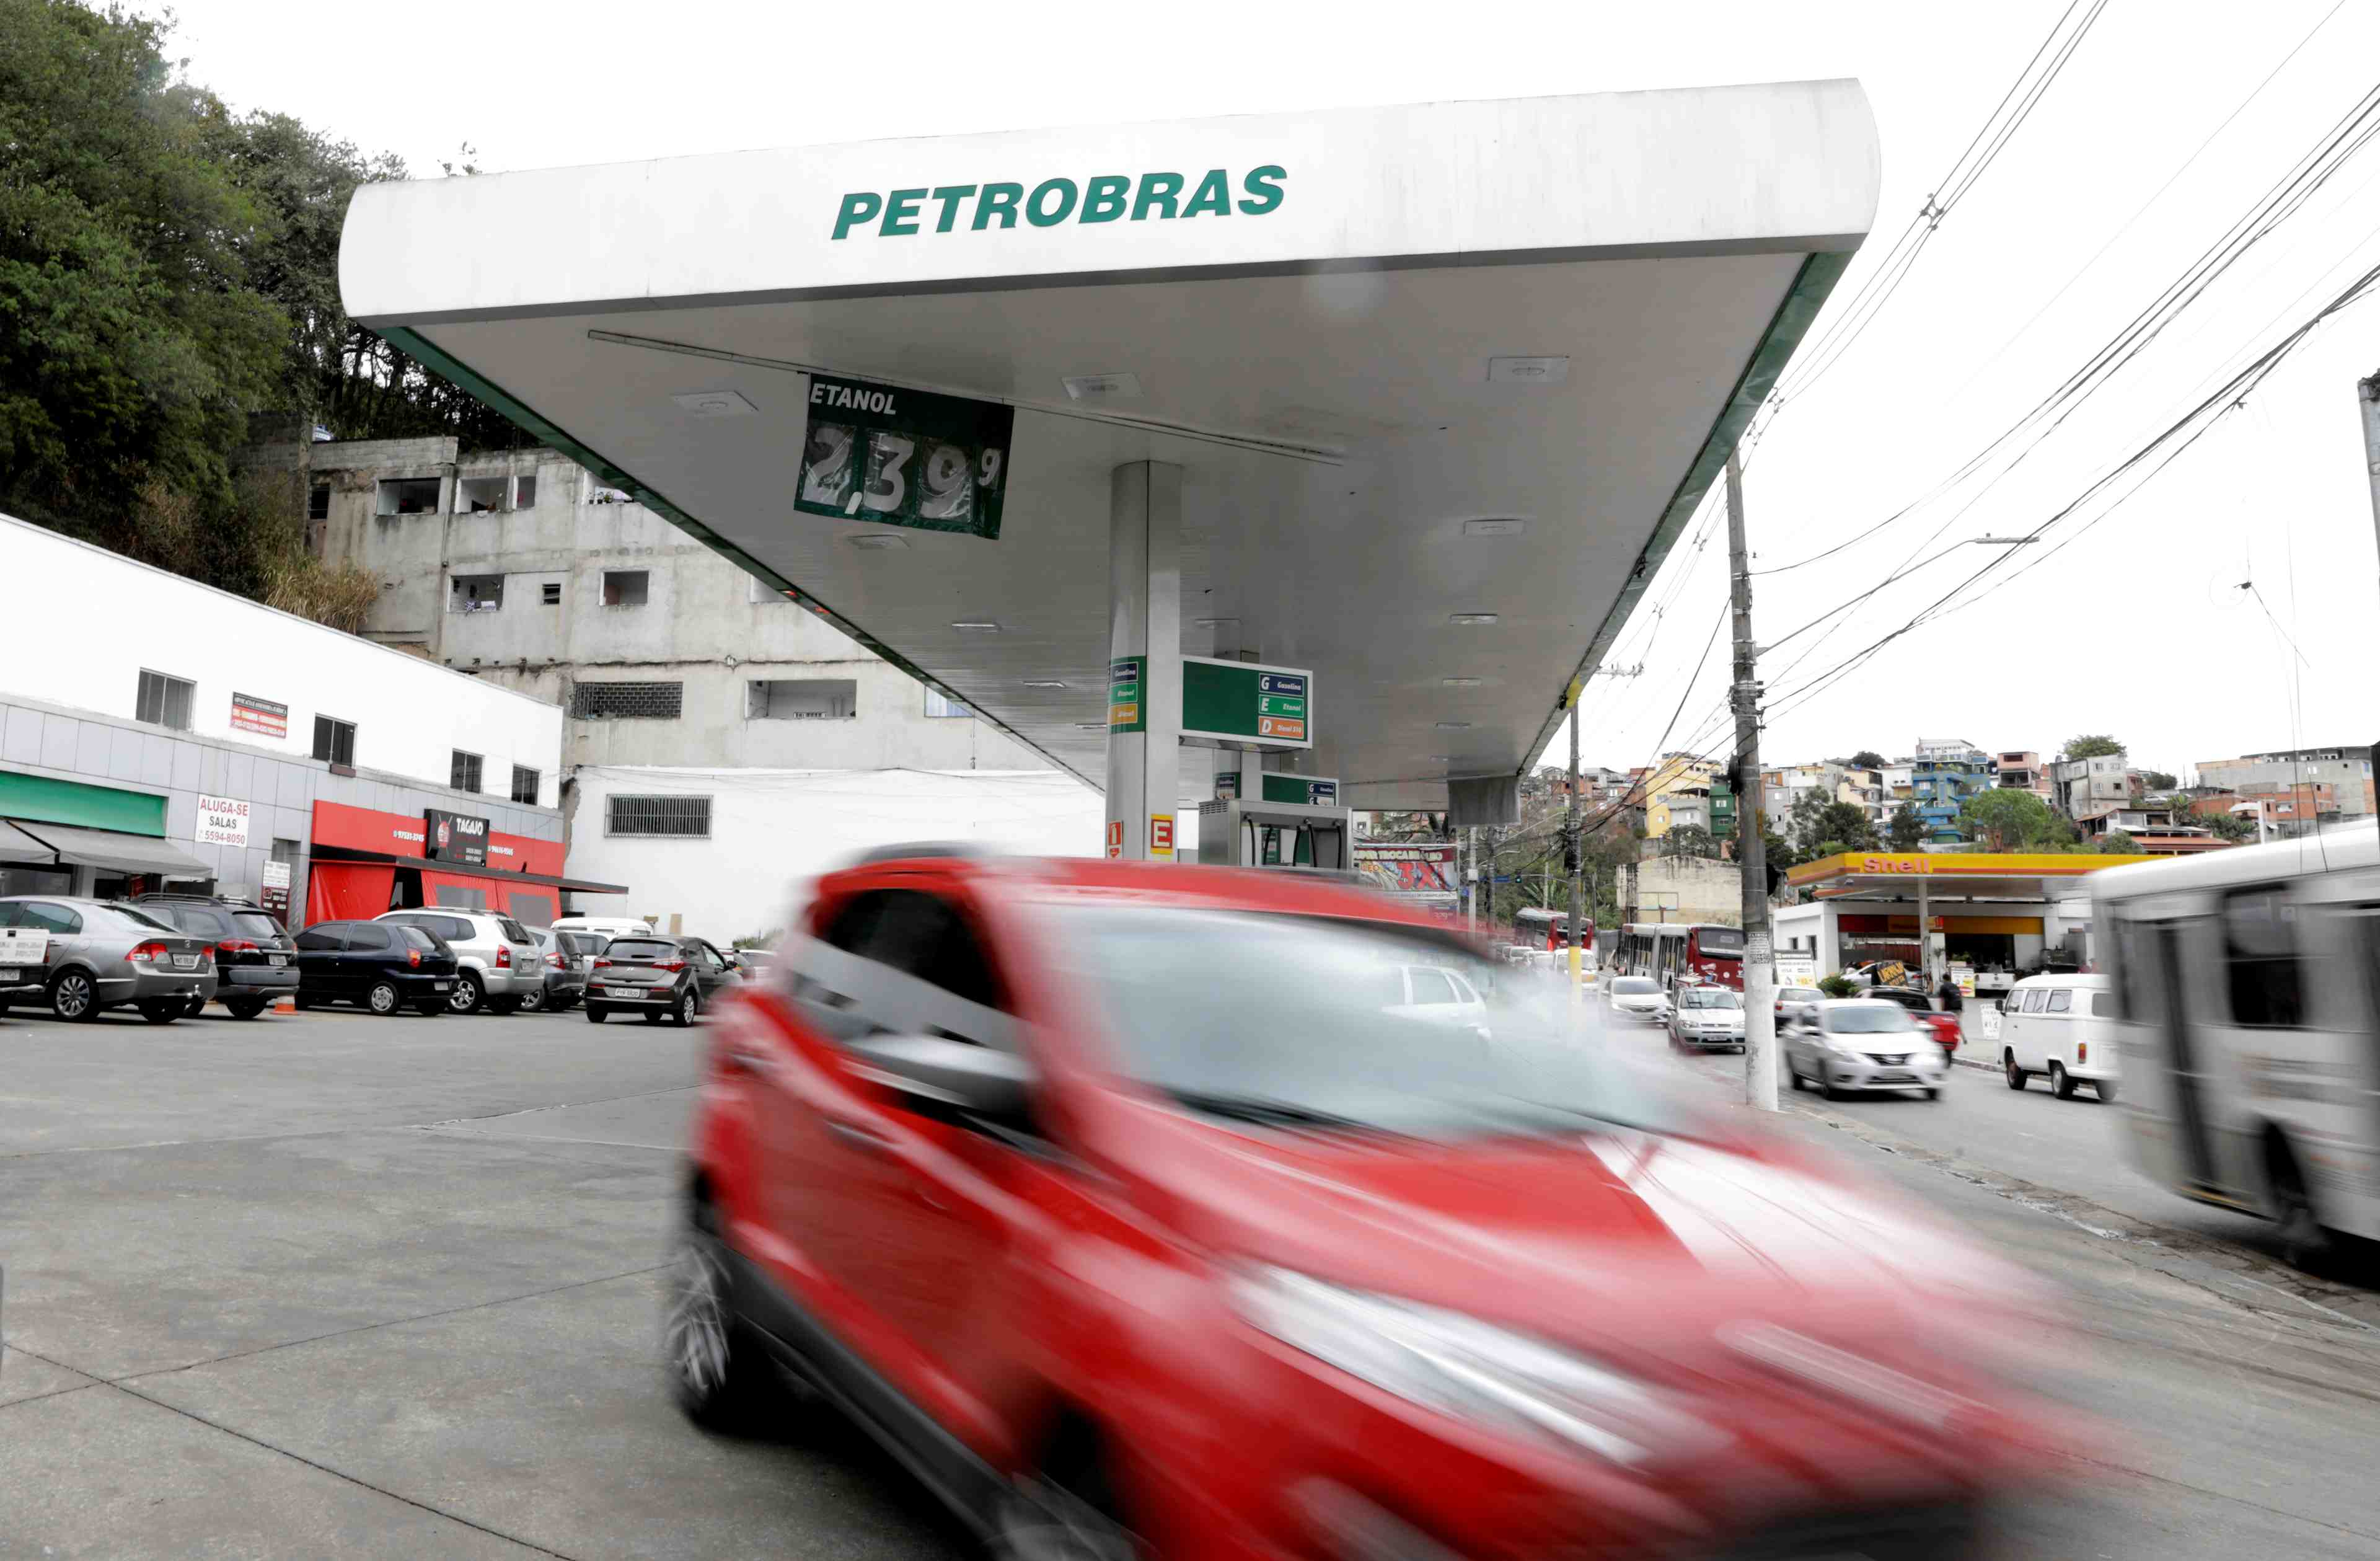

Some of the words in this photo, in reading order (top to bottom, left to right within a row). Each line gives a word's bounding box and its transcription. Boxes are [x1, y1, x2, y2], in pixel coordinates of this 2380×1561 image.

[831, 165, 1287, 240] PETROBRAS
[809, 383, 896, 415] ETANOL
[1261, 676, 1269, 690] G
[1277, 682, 1302, 691] Gasolina
[1261, 697, 1269, 712] E
[1262, 719, 1272, 733] D
[200, 798, 248, 816] ALUGA-SE
[209, 816, 237, 829] SALAS
[205, 831, 245, 844] 5594-8050
[1153, 821, 1170, 847] E
[1864, 858, 1929, 873] Shell
